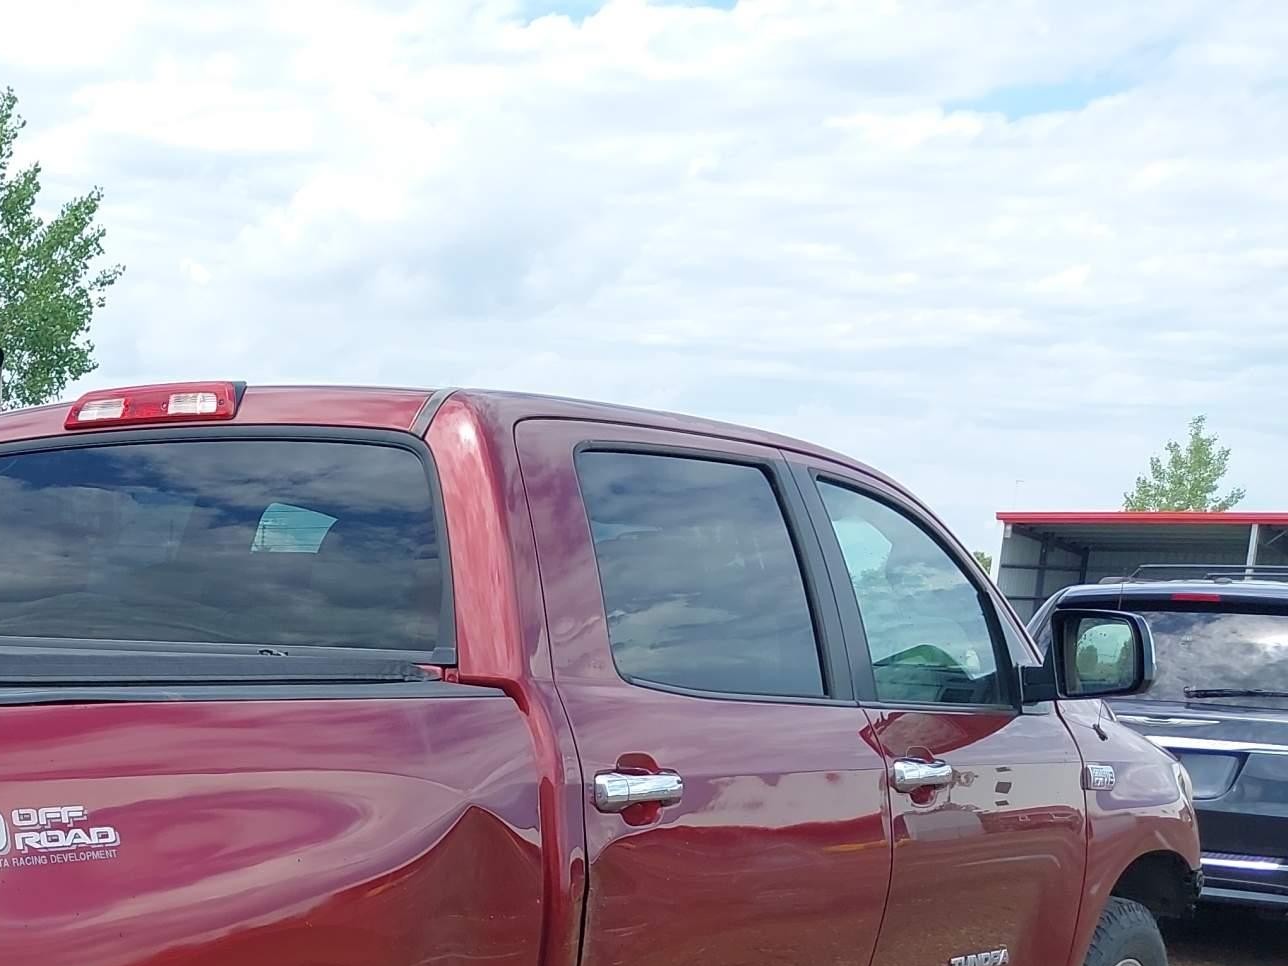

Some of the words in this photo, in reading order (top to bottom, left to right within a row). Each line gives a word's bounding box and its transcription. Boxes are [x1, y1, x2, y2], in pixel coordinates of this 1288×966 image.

[12, 806, 88, 828] OFF
[14, 826, 120, 850] ROAD
[12, 855, 48, 868] RACING
[49, 850, 118, 865] DEVELOPMENT
